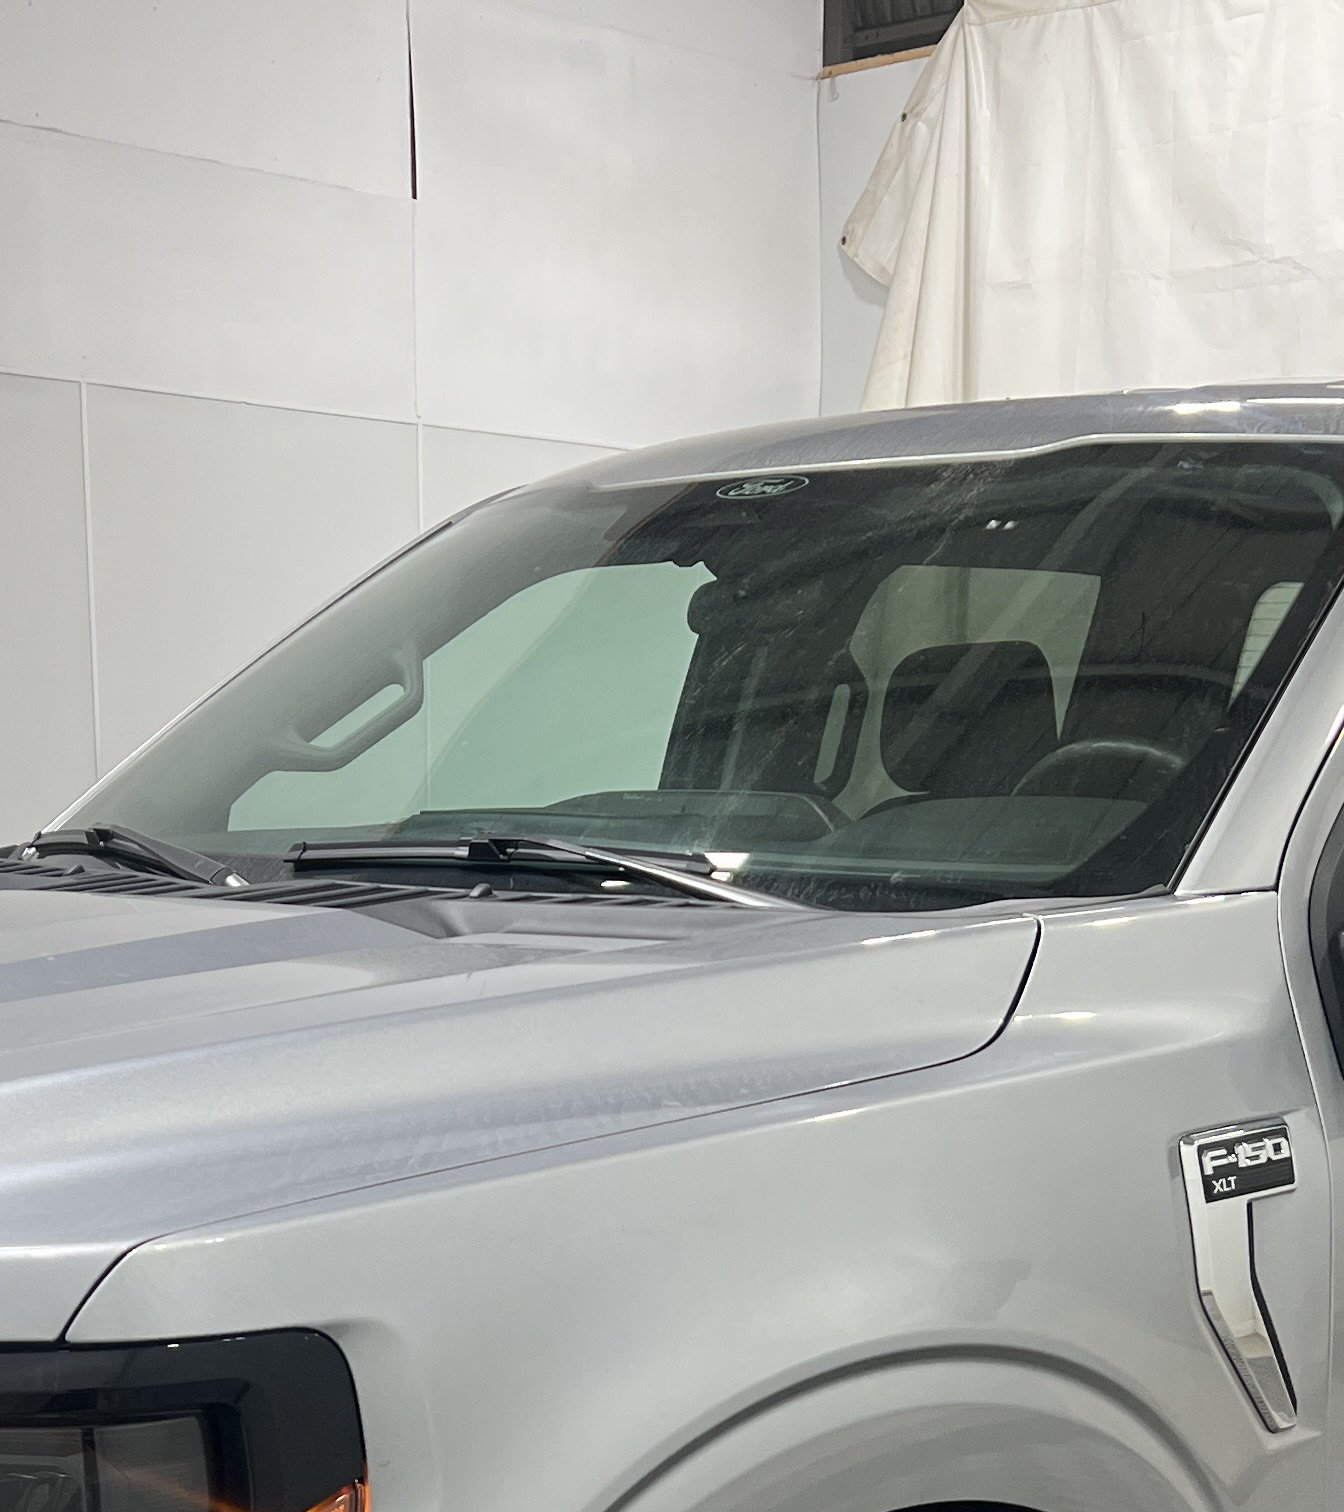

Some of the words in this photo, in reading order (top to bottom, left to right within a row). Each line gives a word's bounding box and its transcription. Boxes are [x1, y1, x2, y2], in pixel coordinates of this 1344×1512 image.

[727, 478, 795, 496] Ford
[1203, 1137, 1291, 1175] F-150
[1211, 1175, 1237, 1194] XLT
